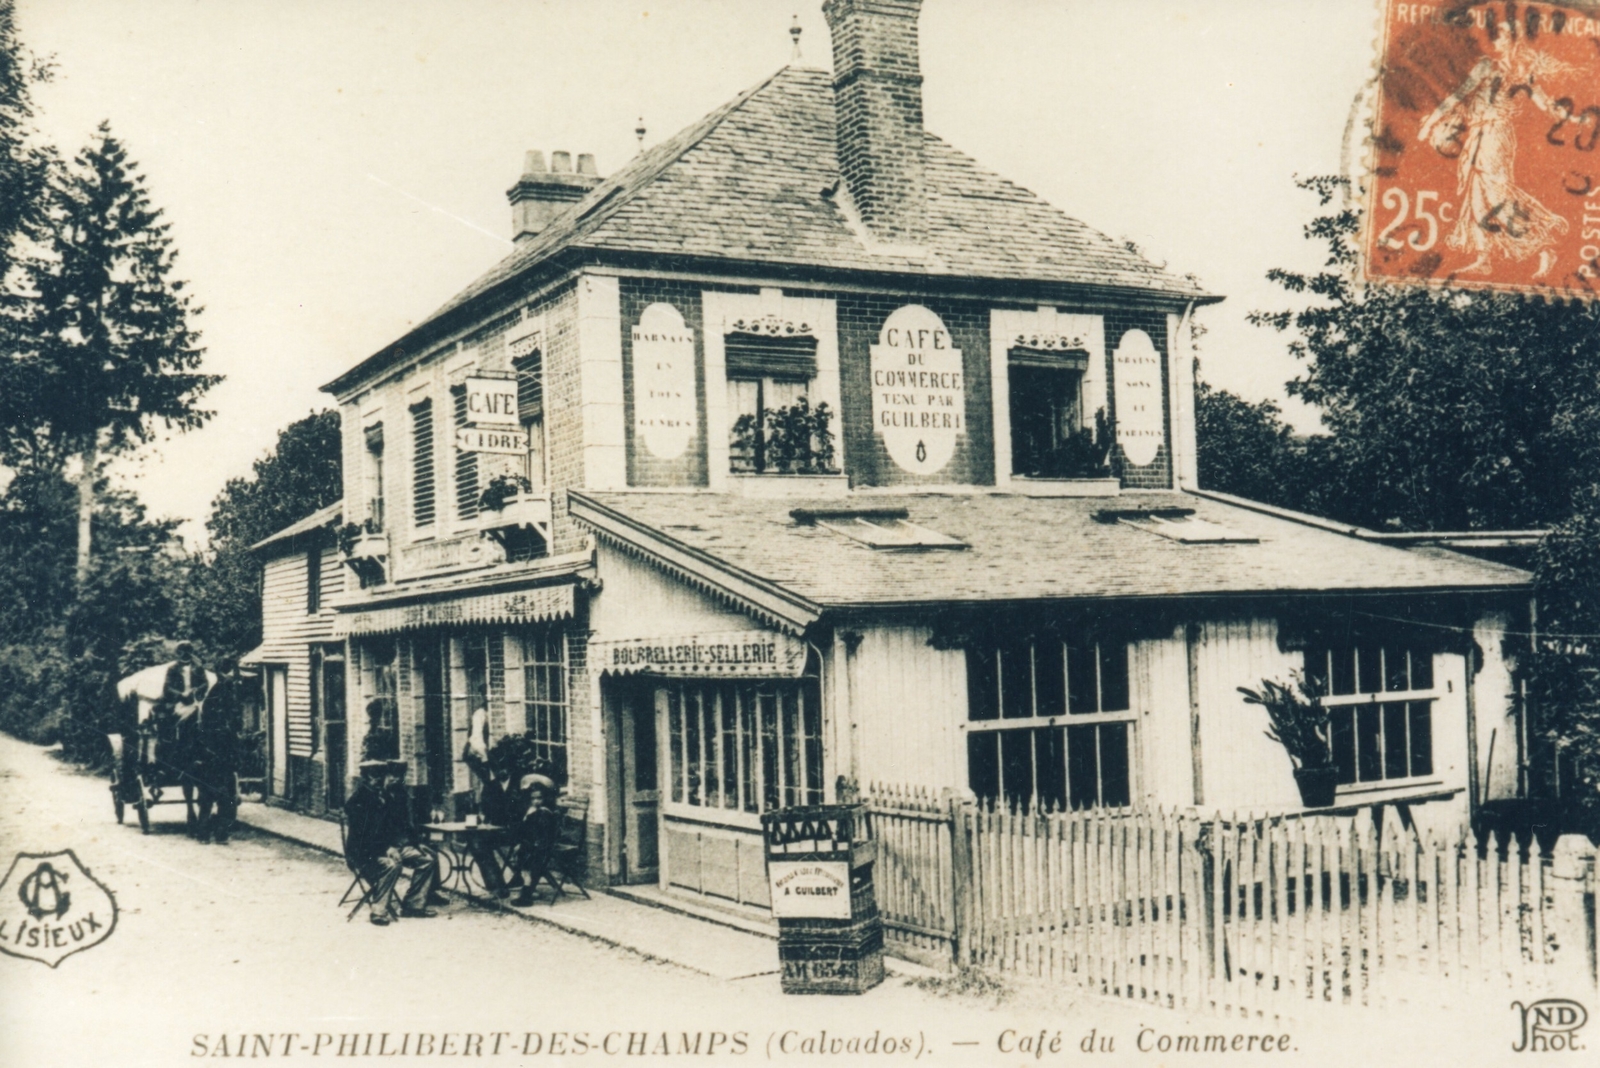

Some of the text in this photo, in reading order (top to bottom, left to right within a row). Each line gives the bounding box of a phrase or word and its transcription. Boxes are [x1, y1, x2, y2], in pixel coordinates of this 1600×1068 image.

[908, 353, 925, 366] DU
[874, 369, 961, 391] COMMERCE
[882, 393, 954, 407] TENU PAR
[881, 410, 961, 429] GUILBERT
[464, 433, 523, 449] CIDRE
[795, 886, 838, 897] GUILBERT
